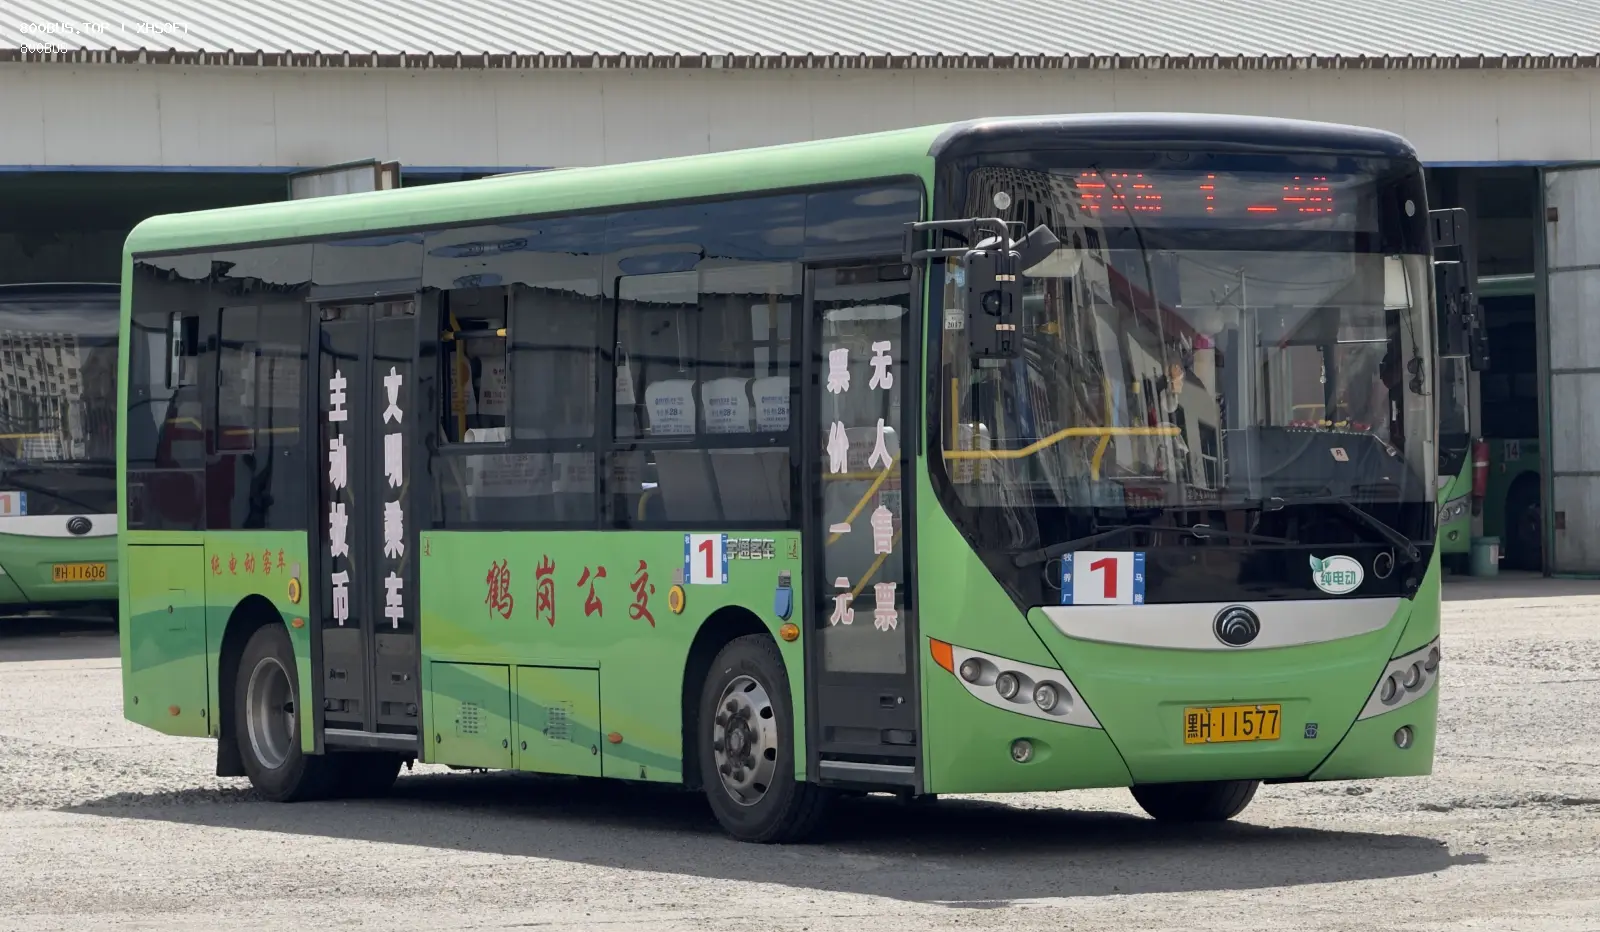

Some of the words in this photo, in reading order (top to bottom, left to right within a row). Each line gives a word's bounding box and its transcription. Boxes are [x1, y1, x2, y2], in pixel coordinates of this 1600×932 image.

[827, 348, 855, 627] 票价一元
[868, 341, 898, 632] 无人售票
[1505, 442, 1519, 459] 14
[329, 369, 349, 626] 主动投币
[383, 366, 404, 629] 文明乘车
[485, 554, 656, 628] 鹤岗公交
[698, 539, 713, 578] 1
[1090, 558, 1117, 598] 1
[1320, 570, 1356, 585] 纯电动
